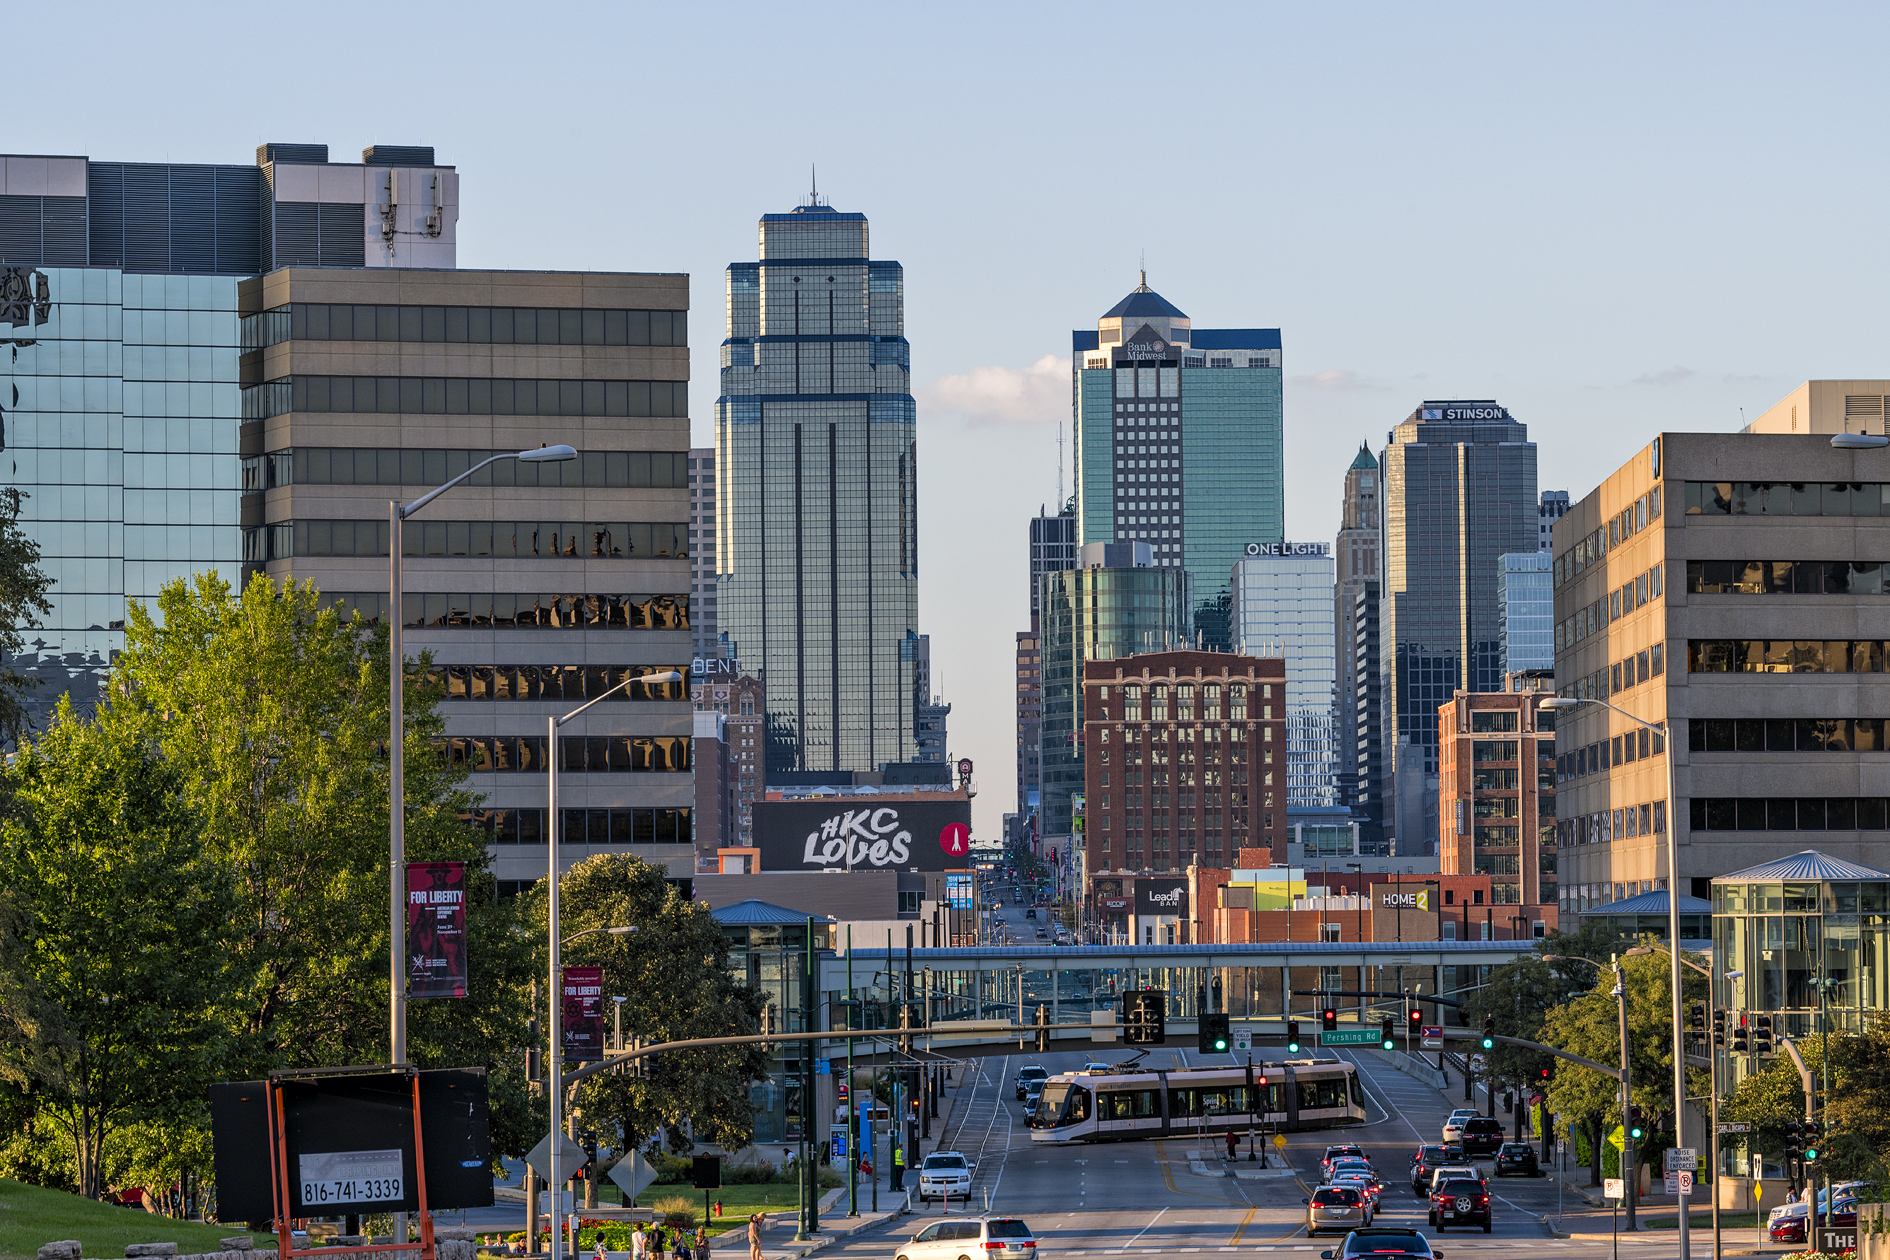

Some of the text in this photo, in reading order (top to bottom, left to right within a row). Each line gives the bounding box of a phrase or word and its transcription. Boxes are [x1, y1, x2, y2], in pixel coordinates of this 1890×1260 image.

[1127, 342, 1152, 351] Bank
[1127, 351, 1166, 360] Midwest
[1447, 408, 1502, 419] STINSON
[1247, 543, 1326, 554] ONE LIGHT
[820, 808, 900, 840] #KC
[411, 890, 463, 904] FOR LIBERTY
[1149, 890, 1173, 901] Lead
[1382, 892, 1427, 909] HOME 2
[565, 986, 601, 996] FOR LIBERTY
[1327, 1033, 1362, 1042] Pershing
[305, 1179, 400, 1202] 816-741-3339
[1824, 1232, 1856, 1248] THE
